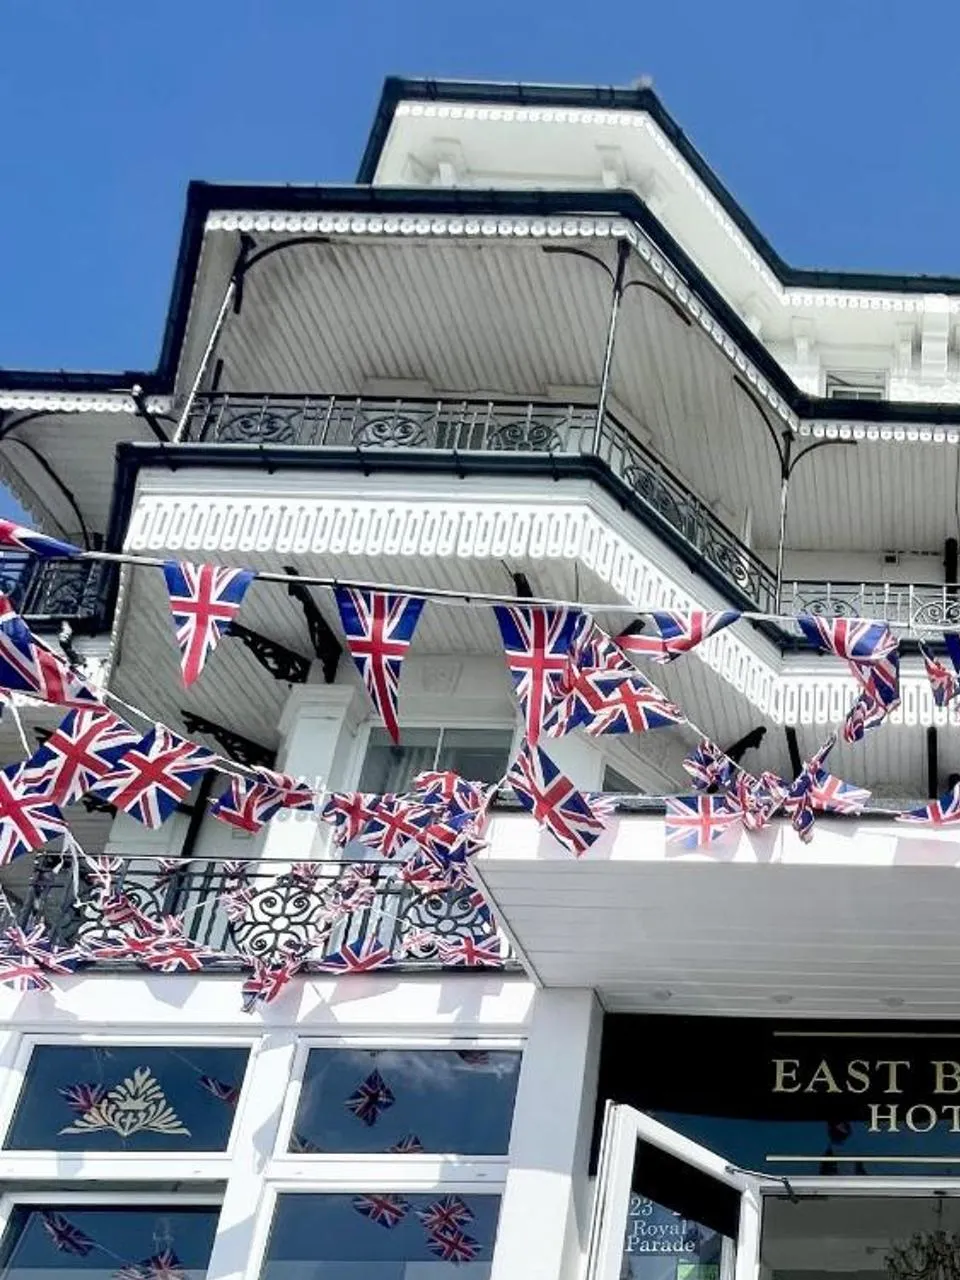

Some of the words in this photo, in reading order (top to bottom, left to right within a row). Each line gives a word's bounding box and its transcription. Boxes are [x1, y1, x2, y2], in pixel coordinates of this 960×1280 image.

[771, 1059, 911, 1094] EAST
[633, 1219, 687, 1240] Royal
[624, 1234, 695, 1252] Parade
